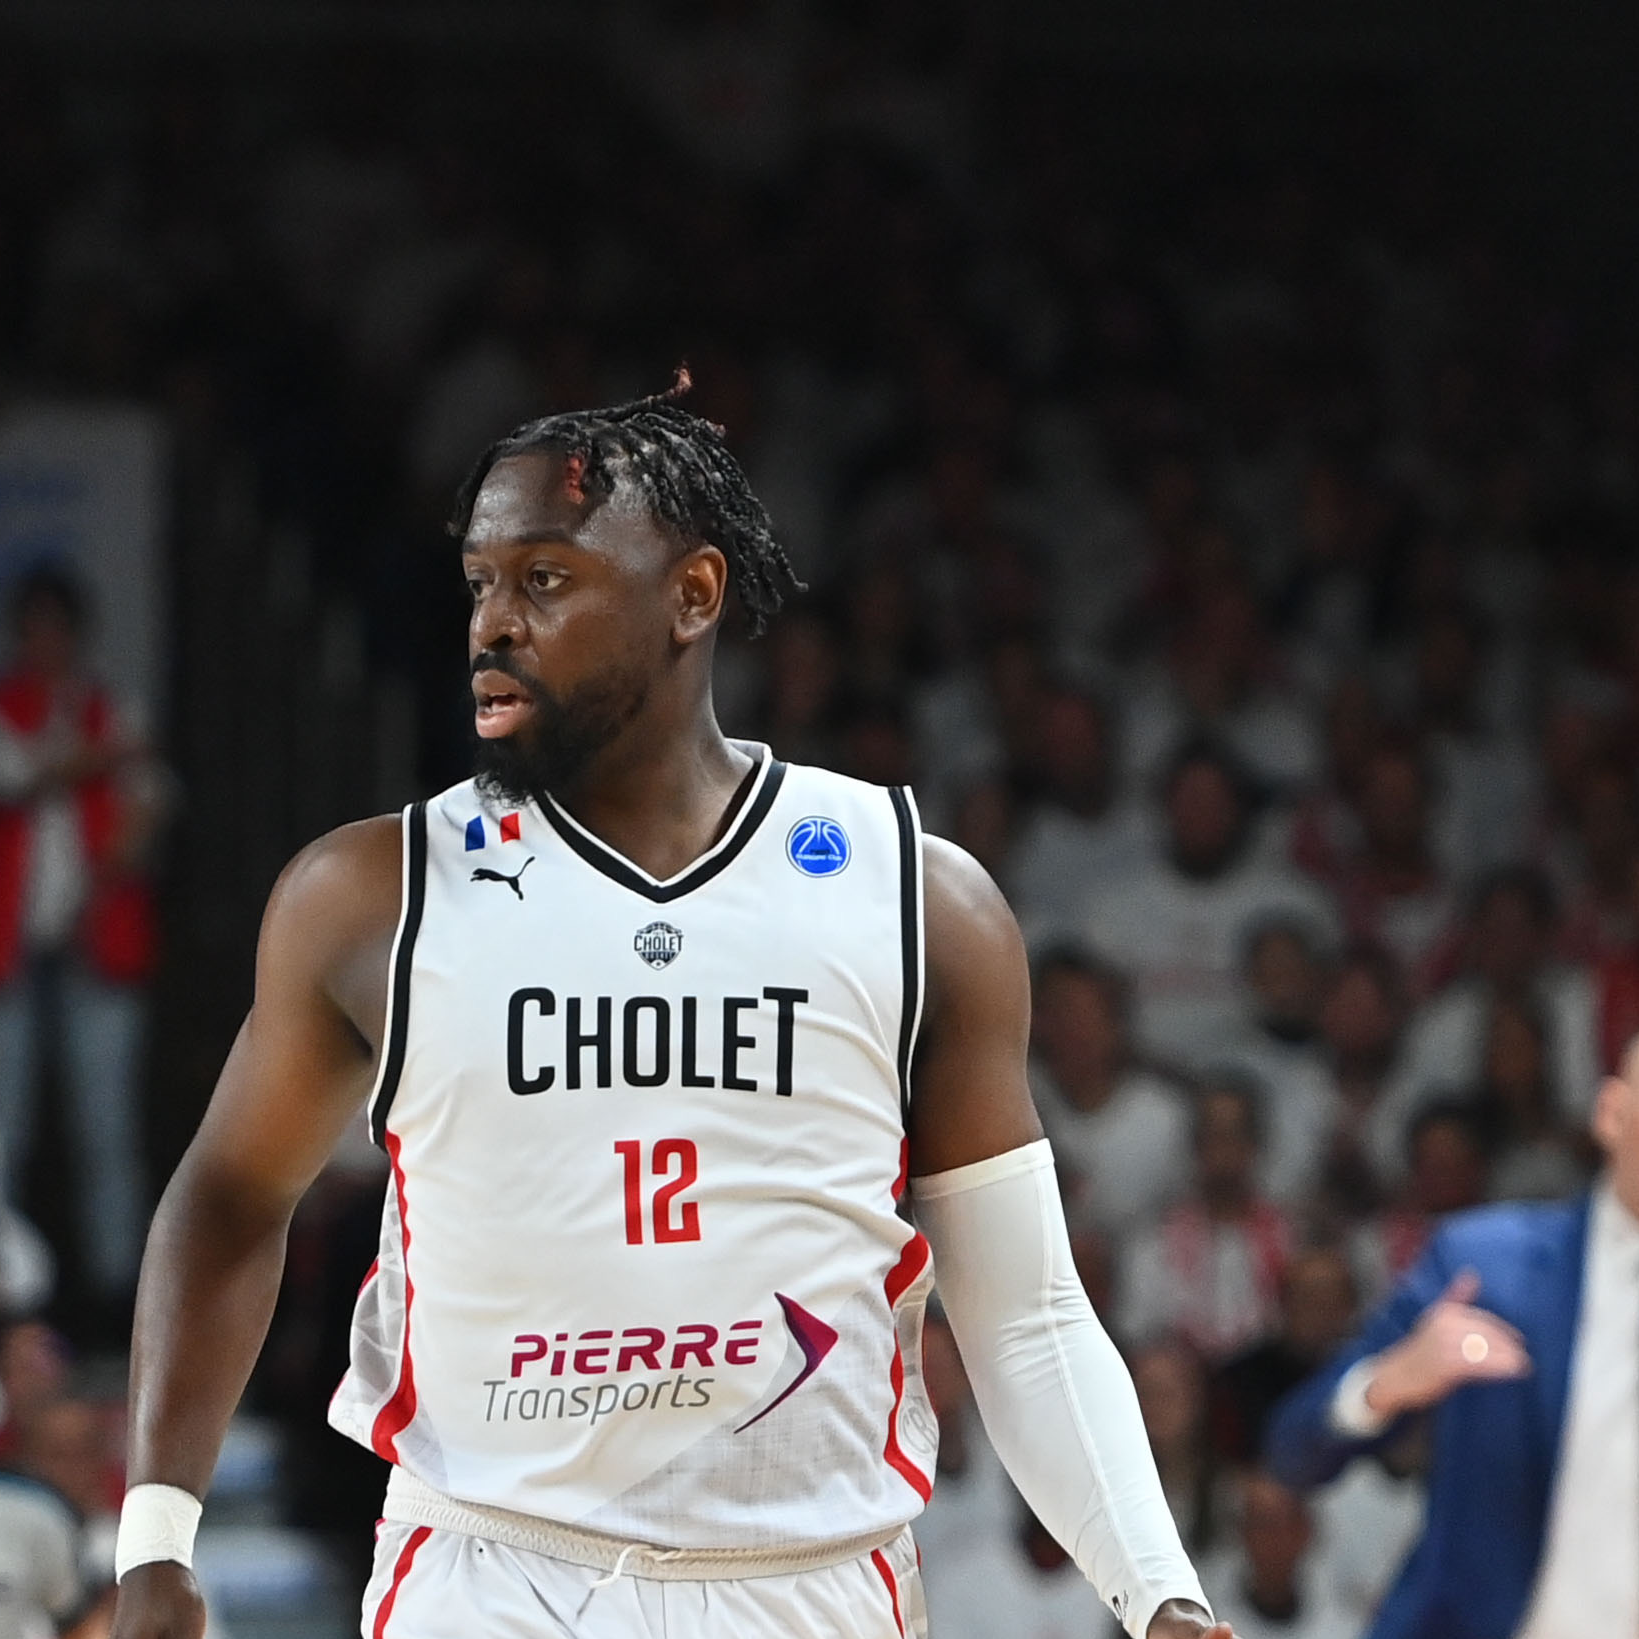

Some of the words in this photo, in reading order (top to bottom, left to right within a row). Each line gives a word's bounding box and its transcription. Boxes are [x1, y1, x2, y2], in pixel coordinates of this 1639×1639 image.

[634, 934, 683, 952] CHOLET
[507, 986, 809, 1097] CHOLET
[614, 1138, 701, 1245] 12
[483, 1373, 715, 1425] Transports
